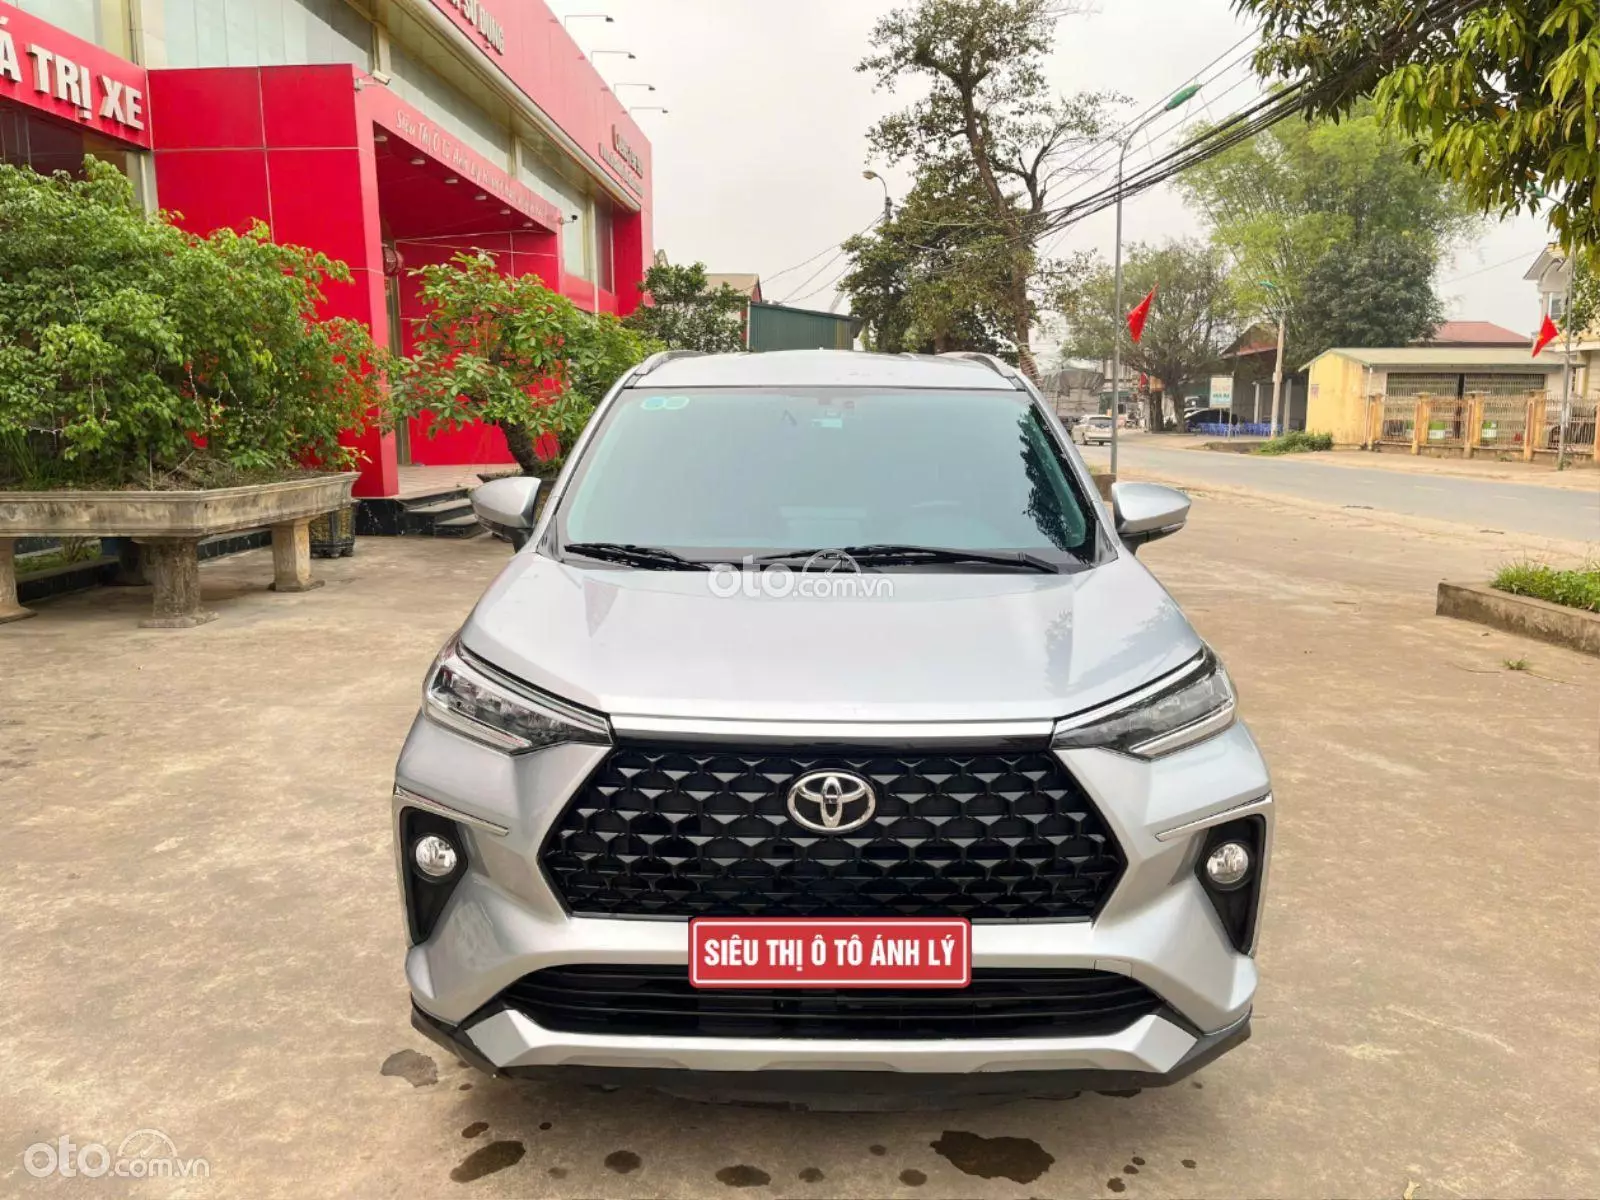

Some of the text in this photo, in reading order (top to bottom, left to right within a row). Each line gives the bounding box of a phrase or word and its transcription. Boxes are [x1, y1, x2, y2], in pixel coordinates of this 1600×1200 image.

[27, 44, 92, 120] TRỊ
[98, 74, 144, 131] XE
[704, 934, 955, 971] SIÊU THỊ Ô TÔ ÁNH LÝ
